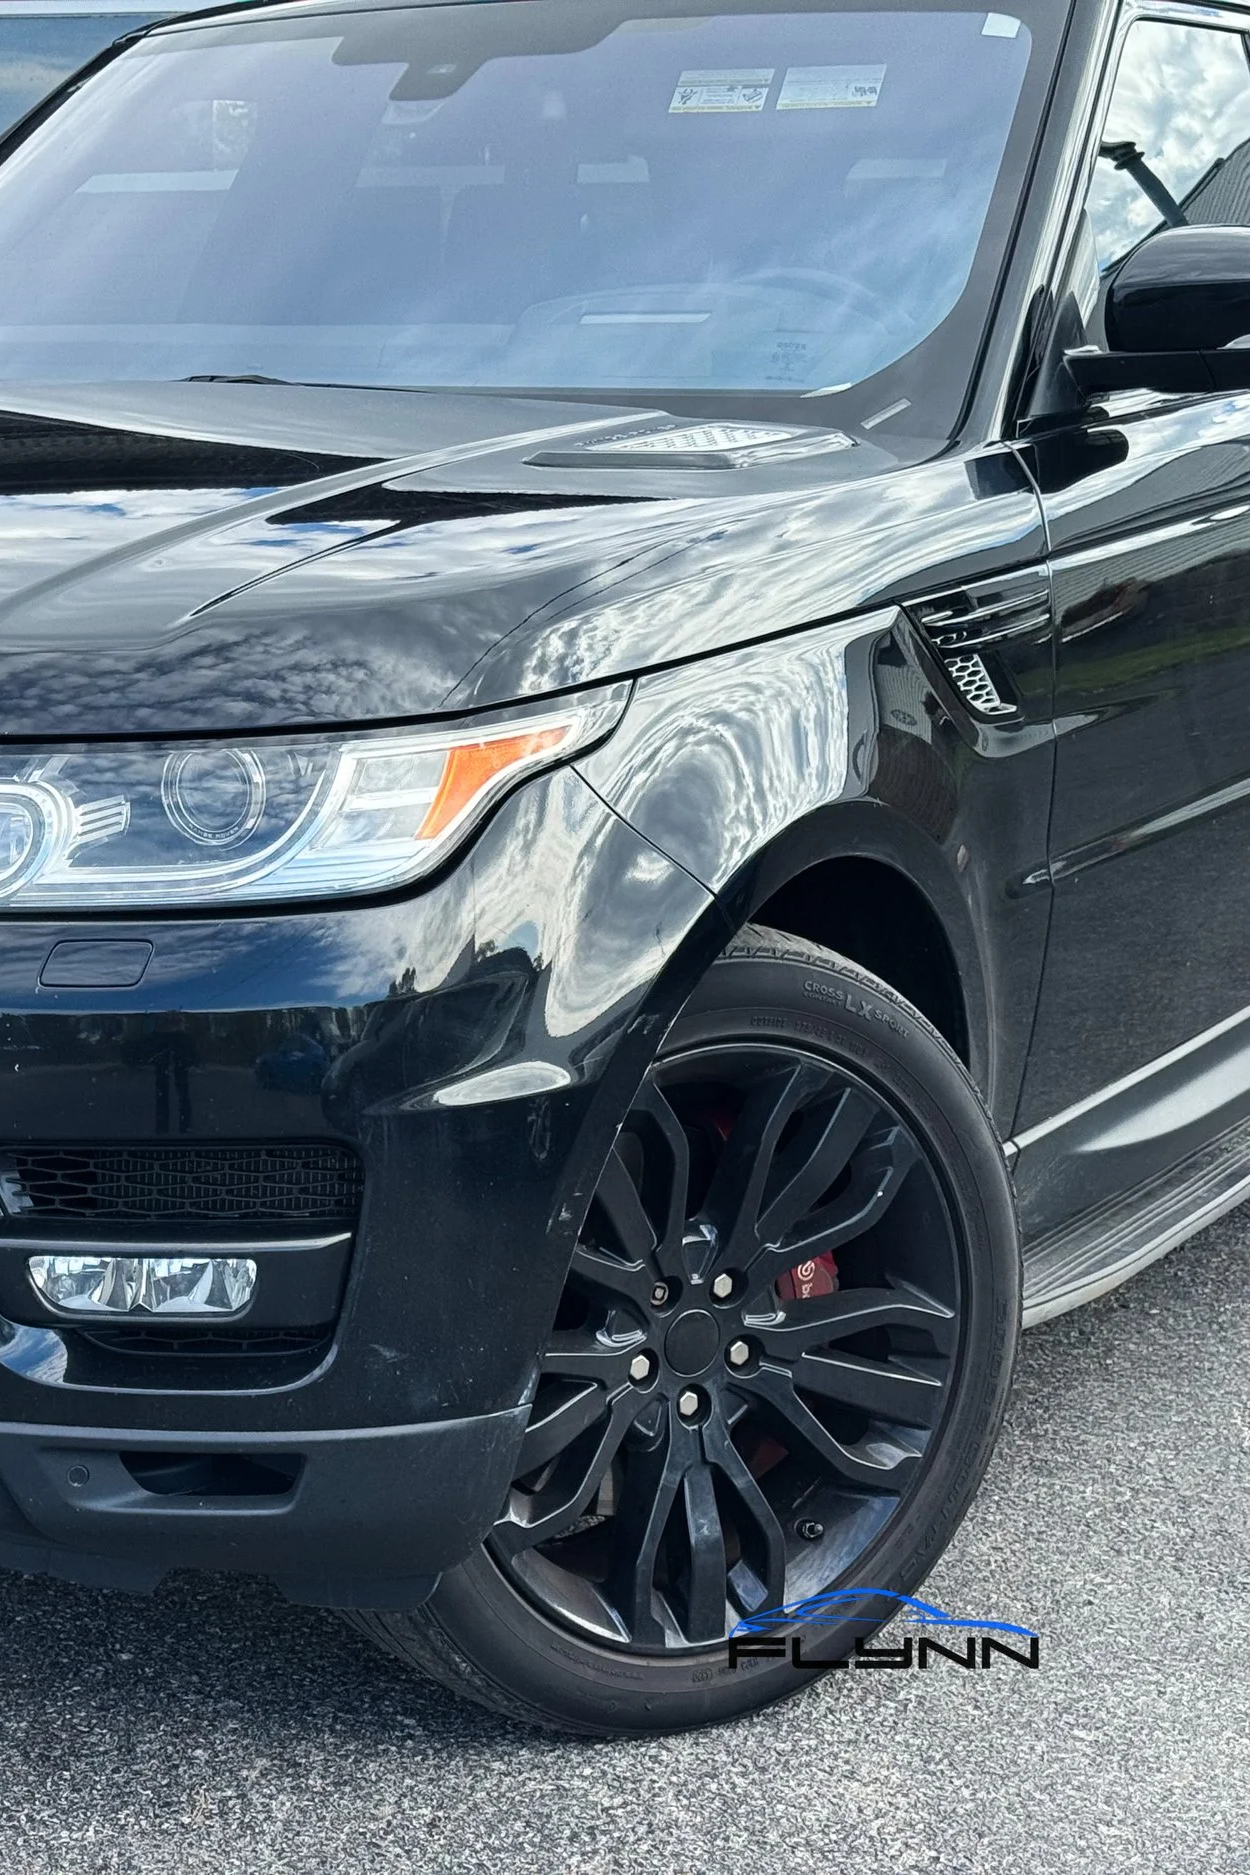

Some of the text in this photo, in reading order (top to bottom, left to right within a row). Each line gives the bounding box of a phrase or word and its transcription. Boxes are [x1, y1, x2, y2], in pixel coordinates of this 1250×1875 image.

[804, 980, 844, 1000] CROSS
[845, 993, 872, 1021] LX
[873, 1009, 910, 1039] SPORT
